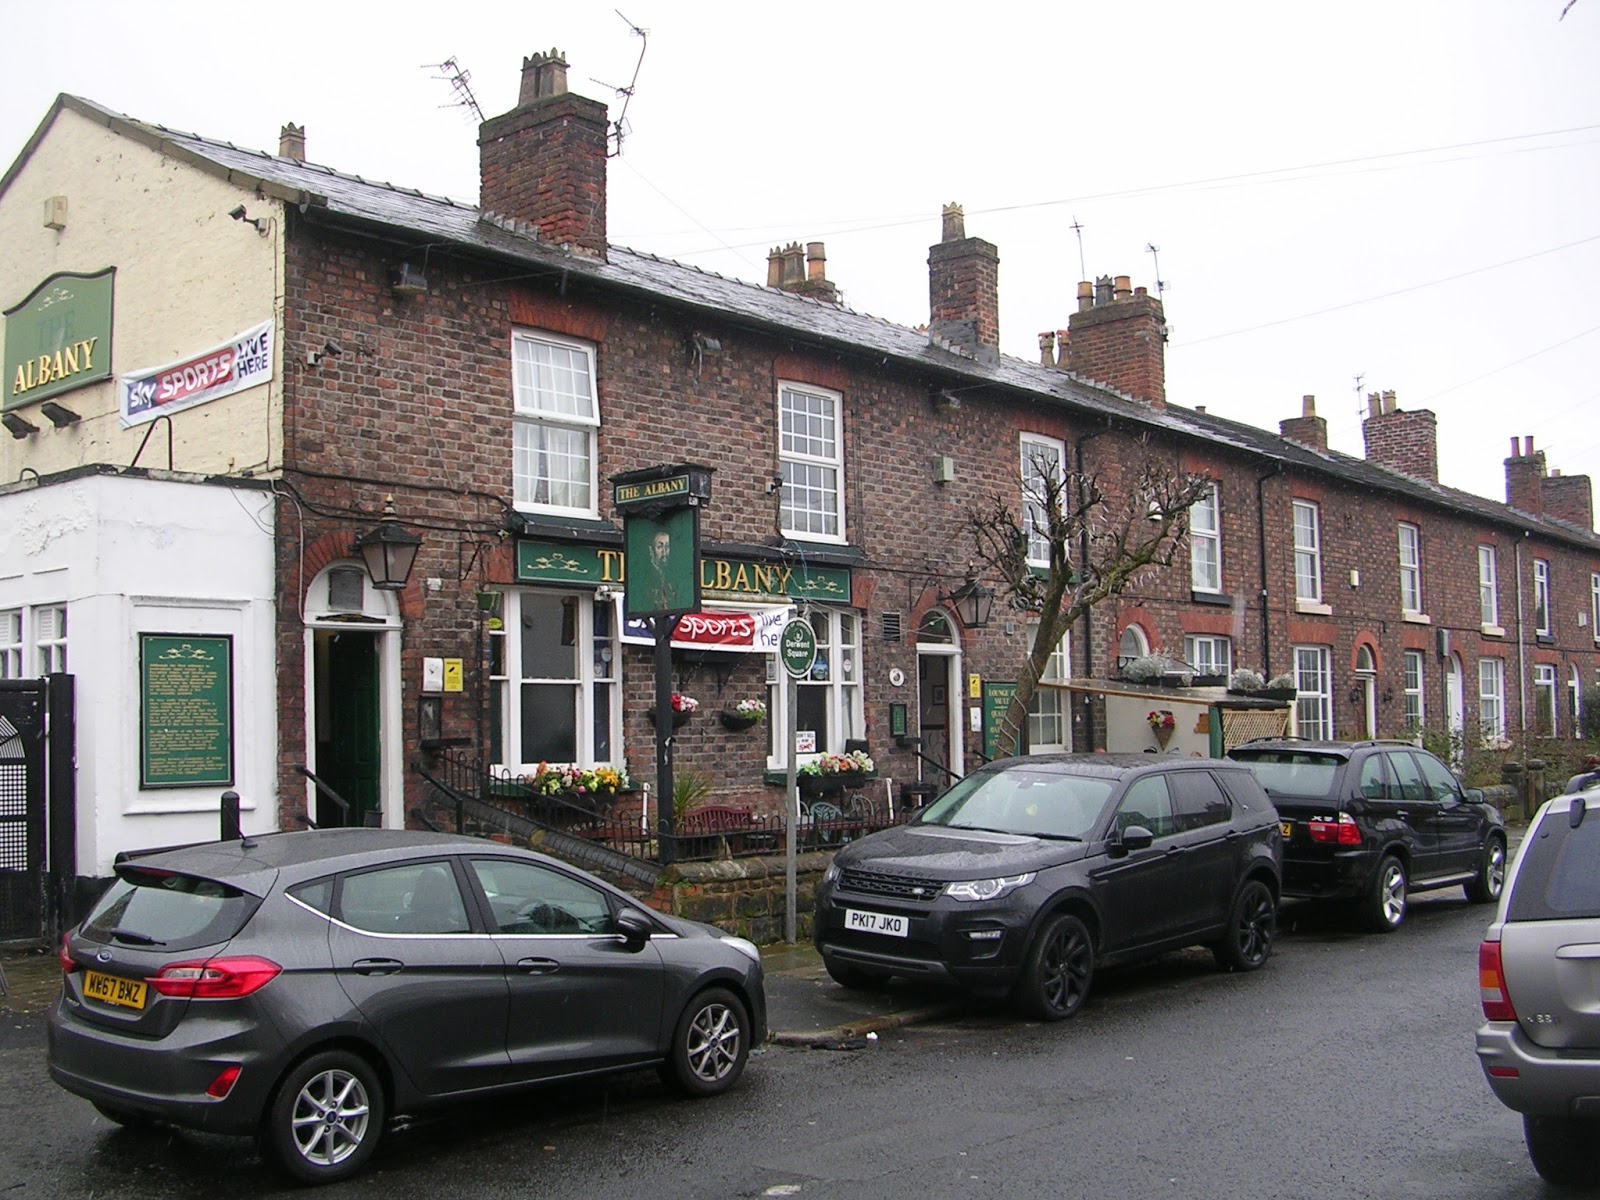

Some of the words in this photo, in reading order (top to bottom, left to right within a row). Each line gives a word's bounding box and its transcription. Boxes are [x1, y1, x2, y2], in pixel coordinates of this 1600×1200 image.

[237, 332, 268, 360] LIVE
[12, 336, 98, 395] ALBANY
[237, 353, 268, 378] HERE
[130, 381, 156, 408] sky
[160, 353, 232, 399] SPORTS
[619, 486, 640, 500] THE
[643, 478, 686, 496] ALBANY
[700, 559, 792, 595] LBANY
[679, 615, 751, 639] sports
[785, 640, 810, 648] Derwent
[787, 649, 808, 658] Square
[988, 689, 1009, 697] LOUNGE
[851, 912, 877, 929] PK17
[879, 917, 902, 932] JKO
